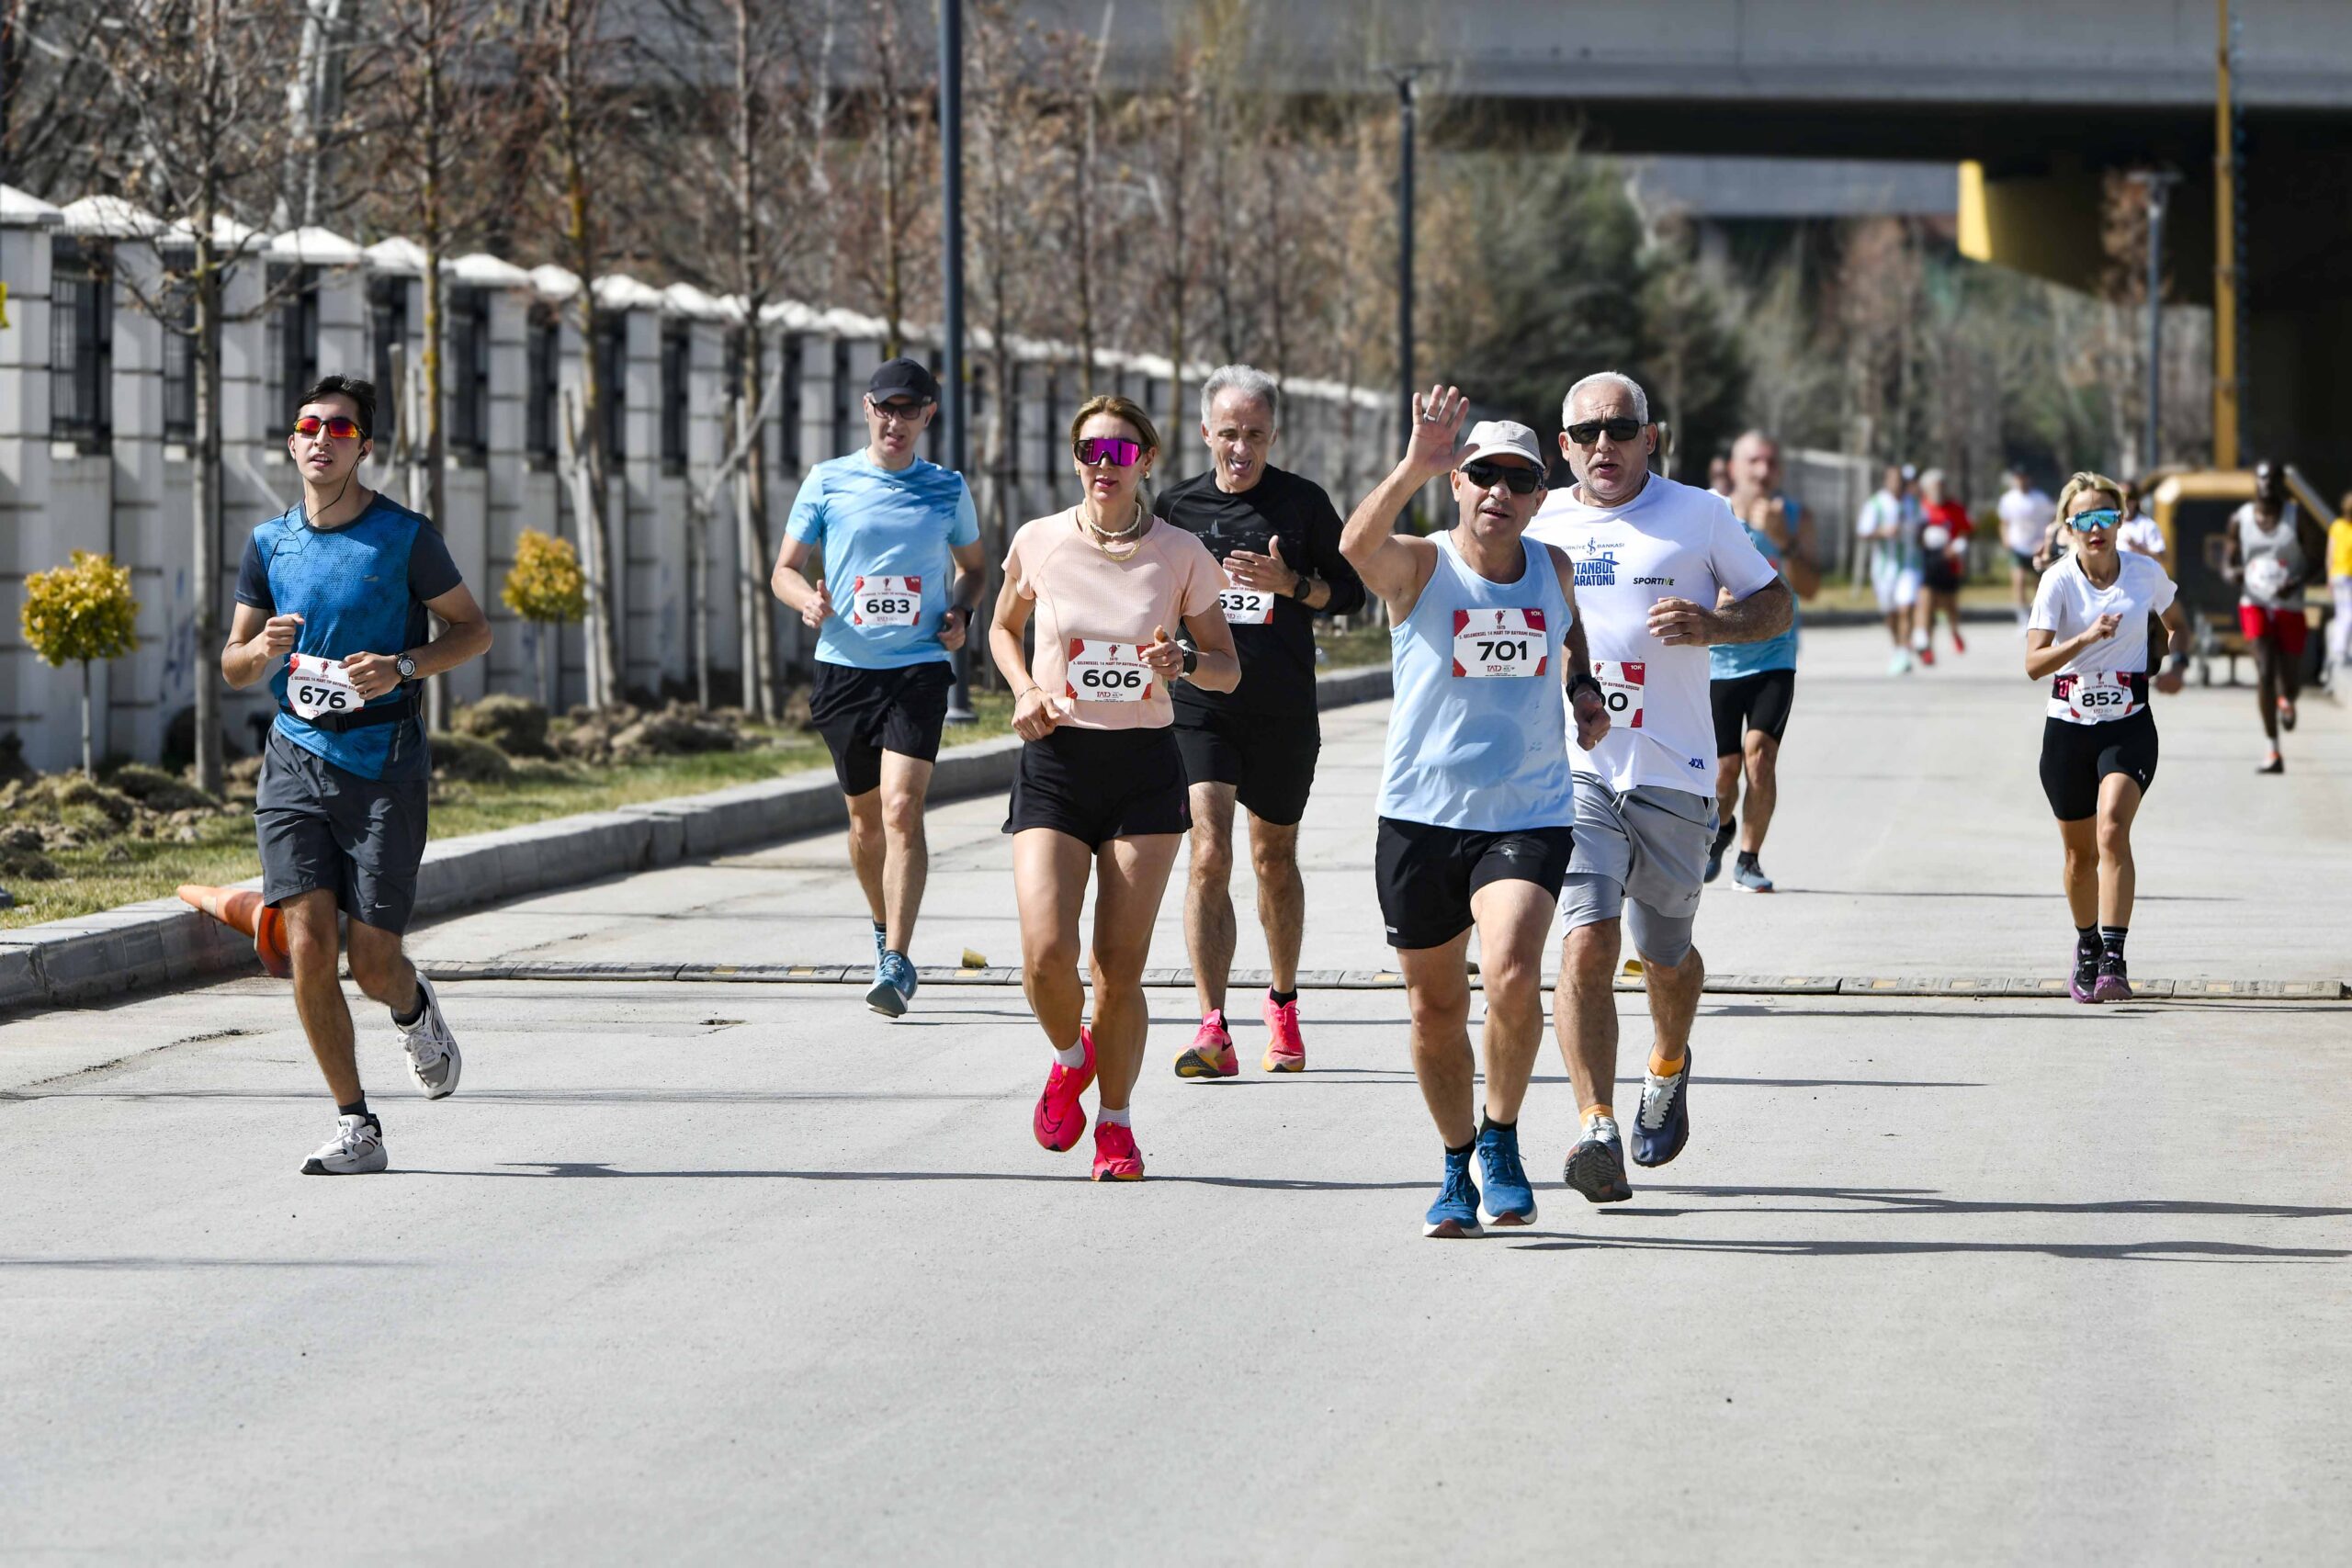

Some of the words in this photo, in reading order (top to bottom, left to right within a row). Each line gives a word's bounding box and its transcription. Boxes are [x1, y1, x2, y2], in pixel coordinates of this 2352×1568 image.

[1572, 561, 1614, 575] TANBUL
[1574, 573, 1615, 586] ARATONU
[1633, 577, 1675, 586] SPORTIVE
[865, 599, 910, 614] 683
[1476, 640, 1527, 661] 701
[1082, 669, 1141, 688] 606
[300, 685, 346, 709] 676
[2081, 692, 2123, 707] 852
